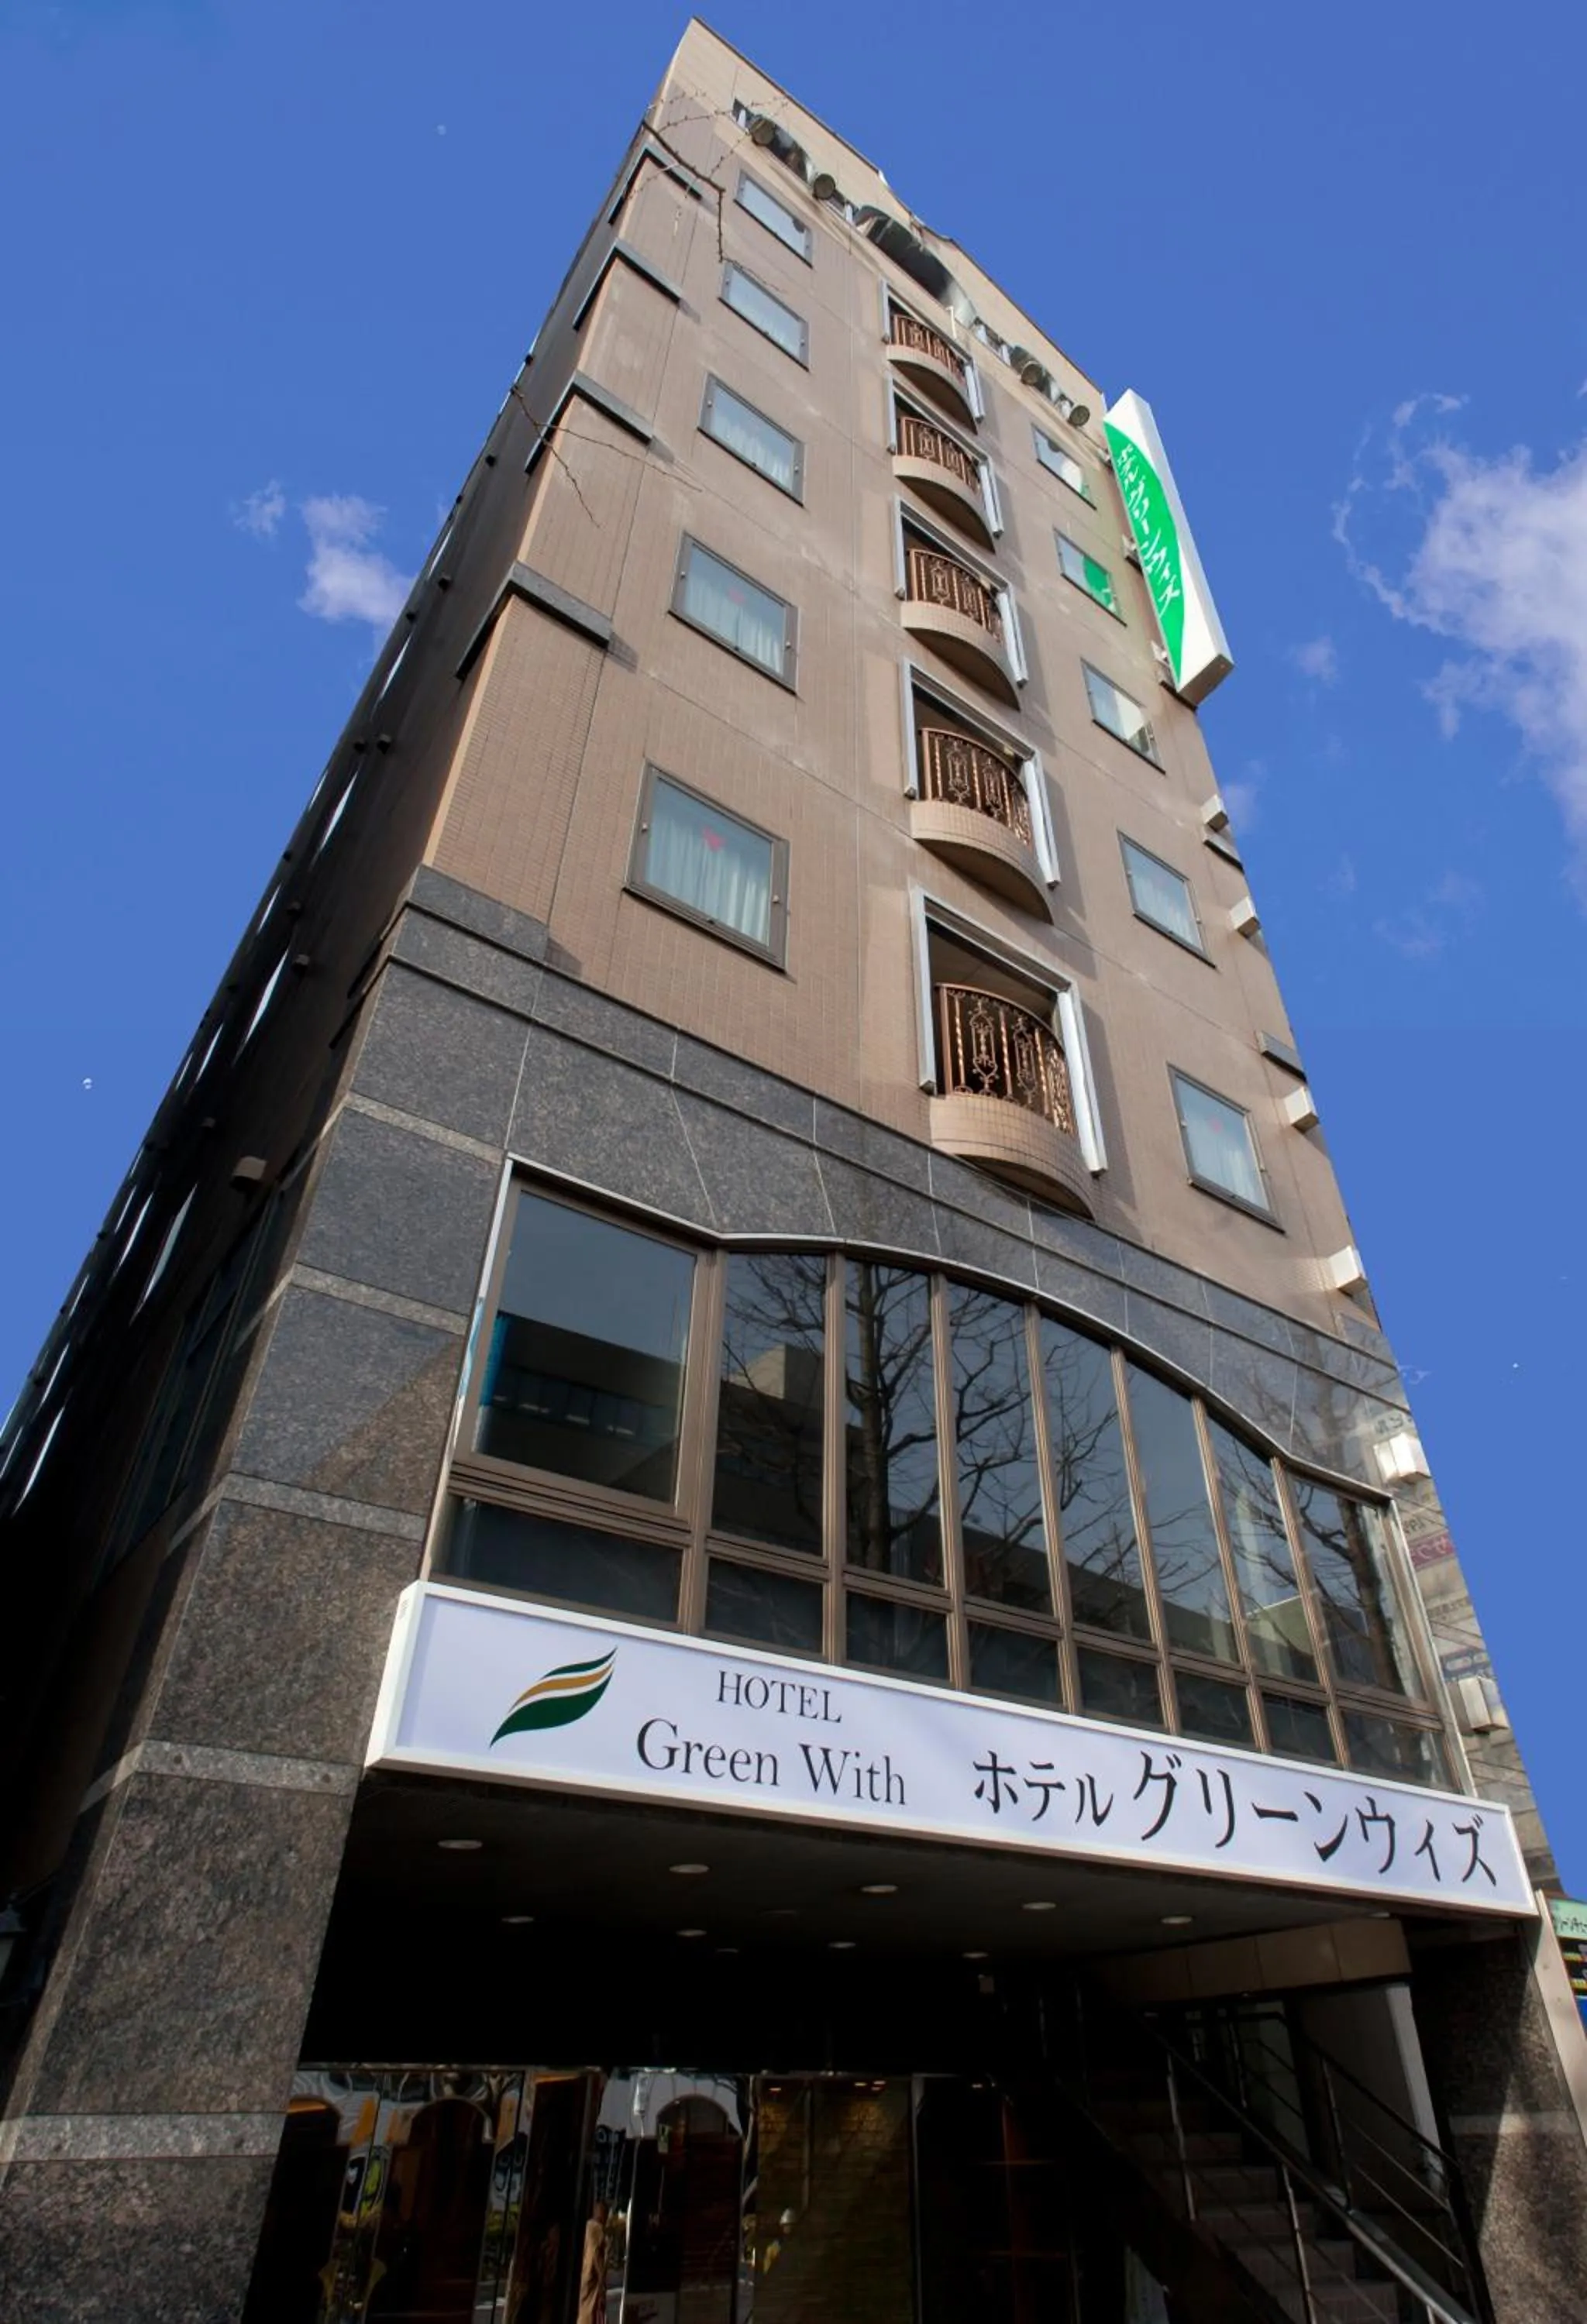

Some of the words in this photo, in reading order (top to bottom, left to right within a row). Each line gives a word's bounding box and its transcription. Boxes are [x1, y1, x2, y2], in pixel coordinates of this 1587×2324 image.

[718, 1670, 842, 1724] HOTEL
[636, 1717, 780, 1786] Green
[798, 1742, 906, 1805] With
